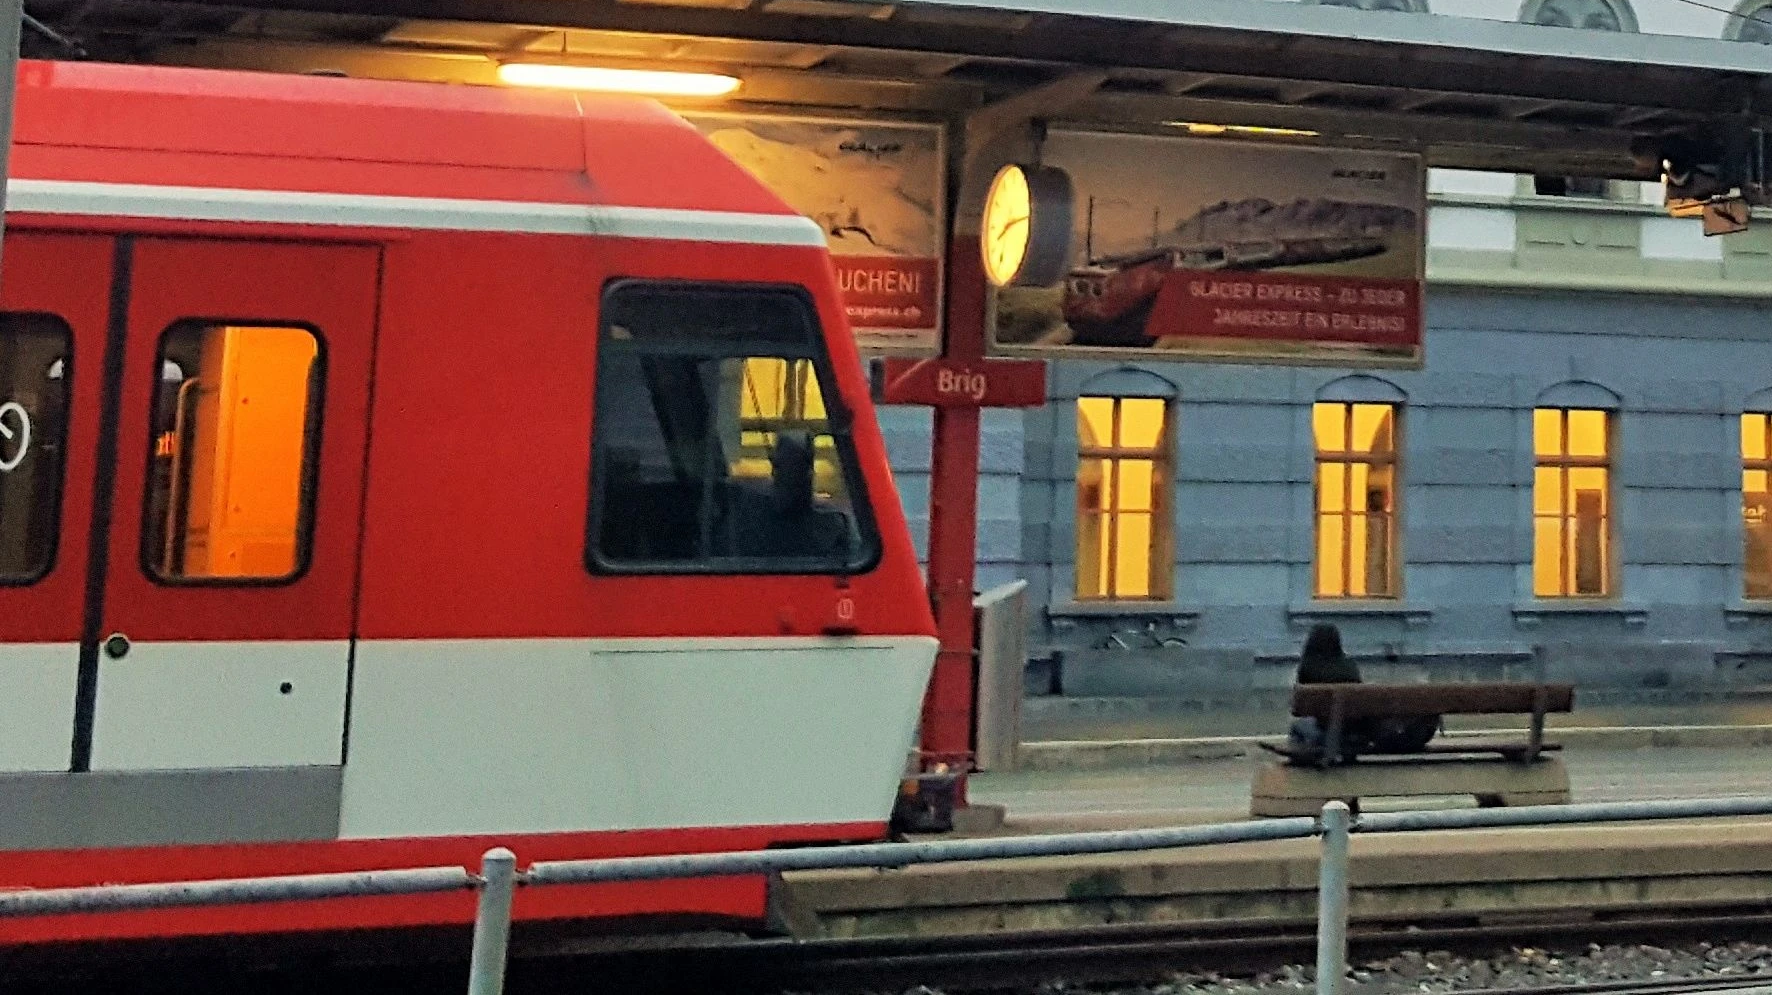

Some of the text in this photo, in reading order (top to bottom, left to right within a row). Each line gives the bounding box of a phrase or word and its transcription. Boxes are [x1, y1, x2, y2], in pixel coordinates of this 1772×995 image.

[1190, 280, 1253, 298] GLACIER
[1257, 283, 1322, 302] EXPRESS
[939, 368, 985, 400] Brig
